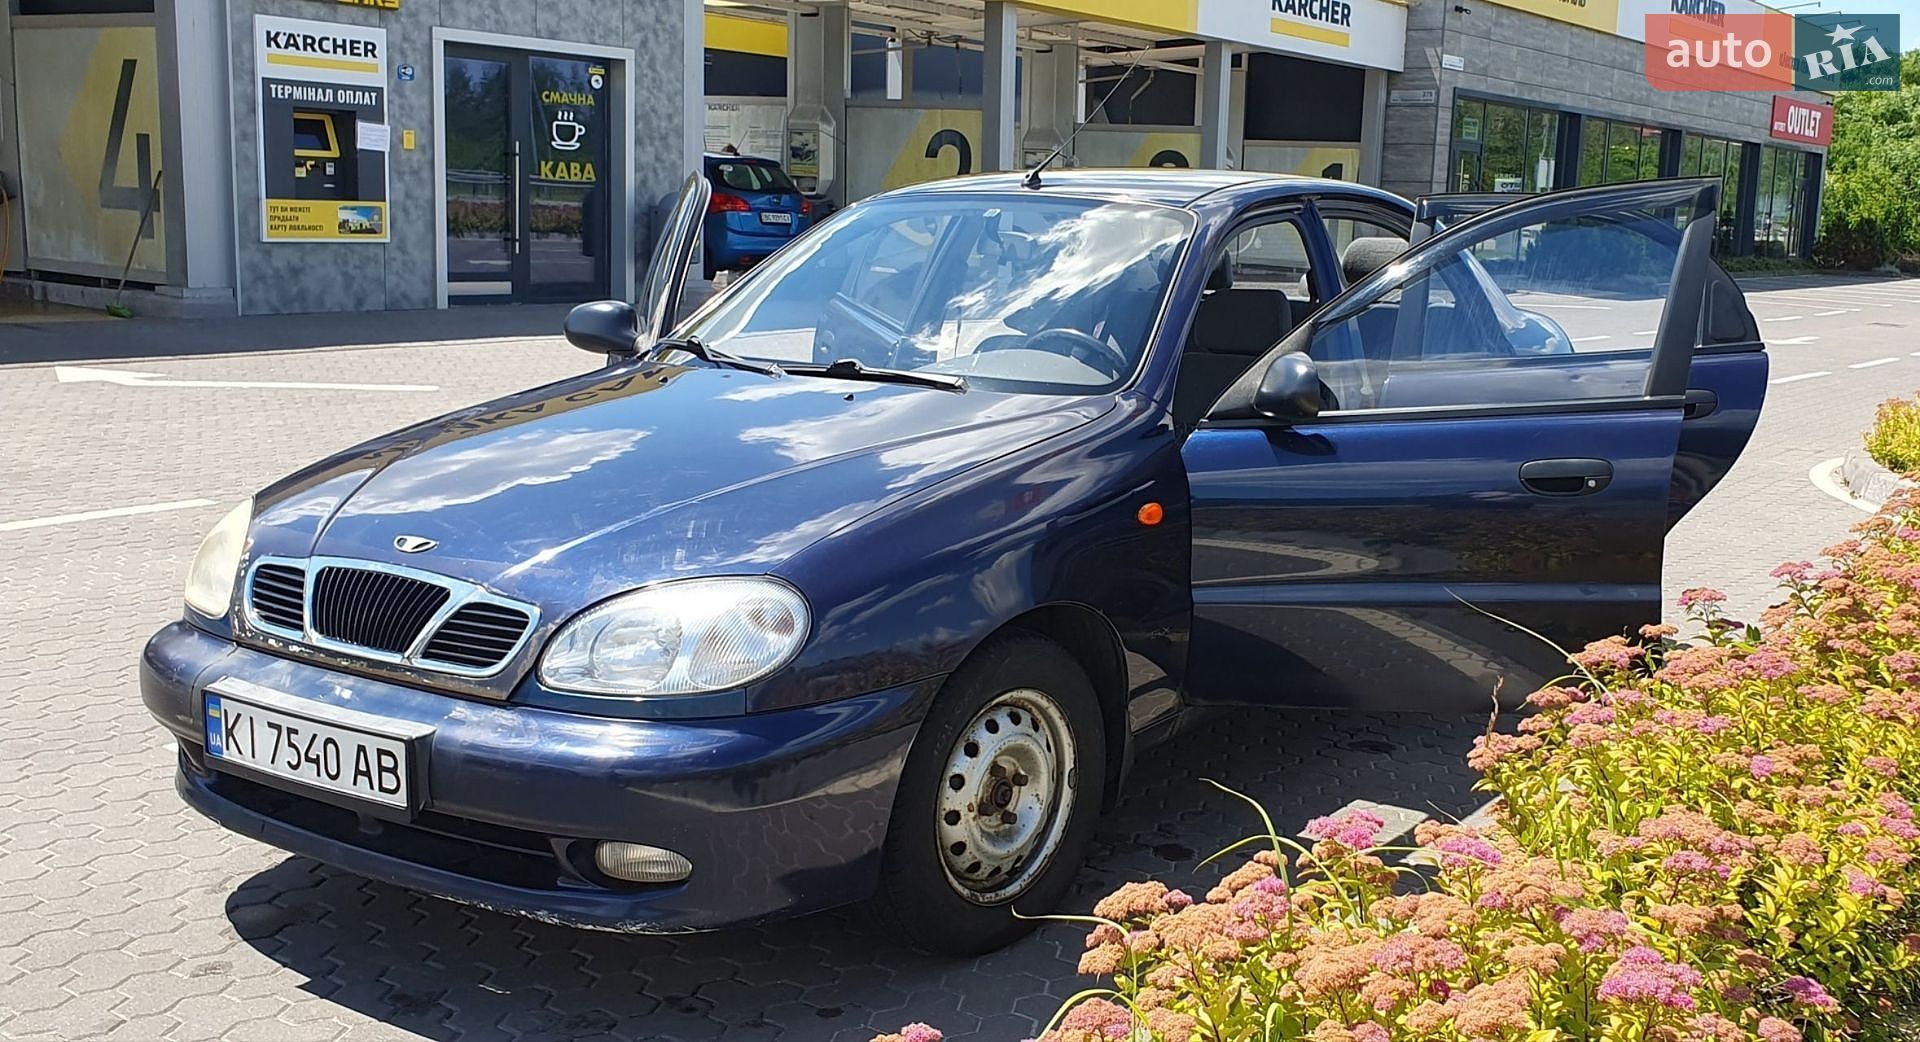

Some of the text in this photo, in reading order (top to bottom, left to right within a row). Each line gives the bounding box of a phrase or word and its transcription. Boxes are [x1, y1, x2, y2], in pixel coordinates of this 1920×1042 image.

[266, 30, 378, 58] KÄRCHER
[269, 84, 377, 106] ТЕРМІНАЛ ОПЛАТ
[542, 90, 595, 106] СМАЧНА
[1787, 105, 1821, 138] OUTLET
[98, 58, 161, 240] 4
[540, 160, 597, 182] КАВА
[269, 215, 299, 223] ПРИДБАТИ
[269, 224, 287, 232] КАРТУ
[209, 733, 222, 748] UA
[224, 709, 401, 795] KI 7540 AB
